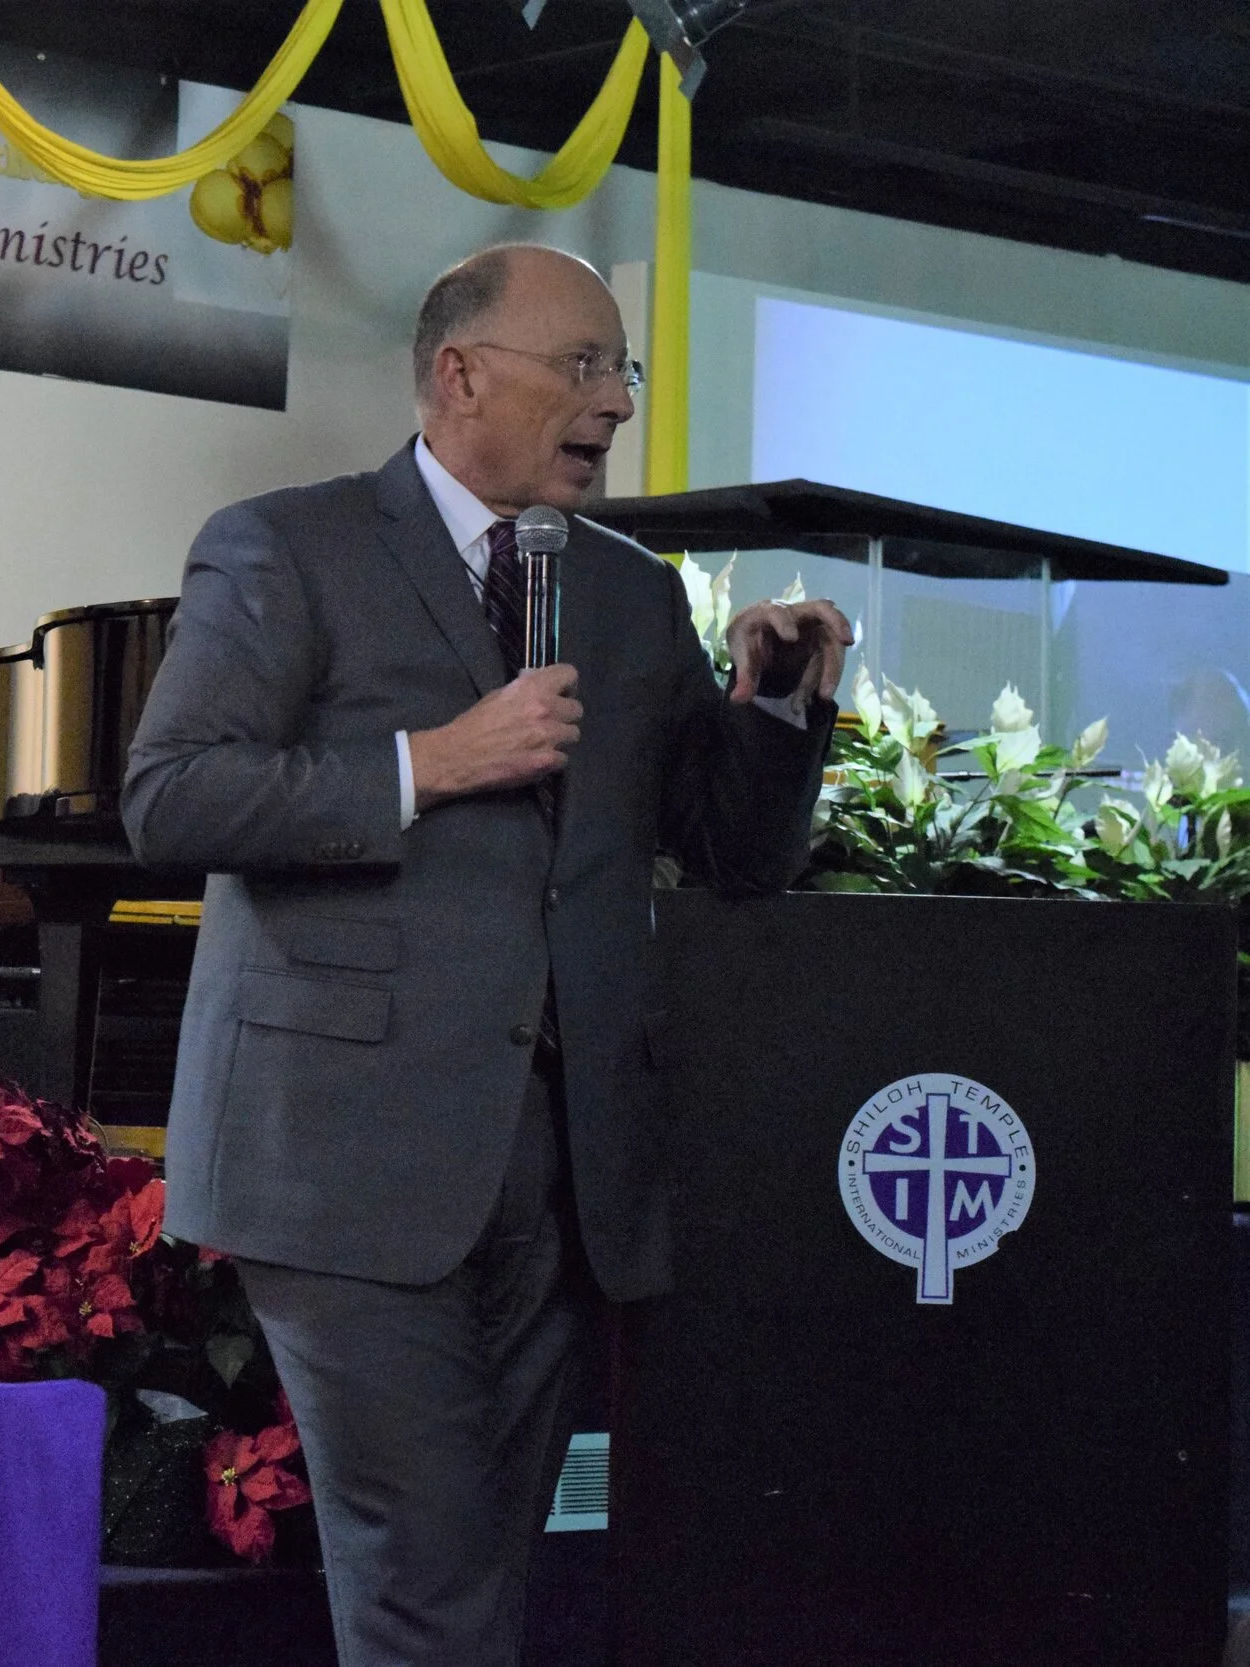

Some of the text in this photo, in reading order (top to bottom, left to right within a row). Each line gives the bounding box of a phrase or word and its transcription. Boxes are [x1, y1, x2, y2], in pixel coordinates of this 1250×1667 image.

[846, 1080, 1029, 1158] SHILOH TEMPLE
[849, 1173, 1026, 1260] INTERNATIONAL MINISTRIES
